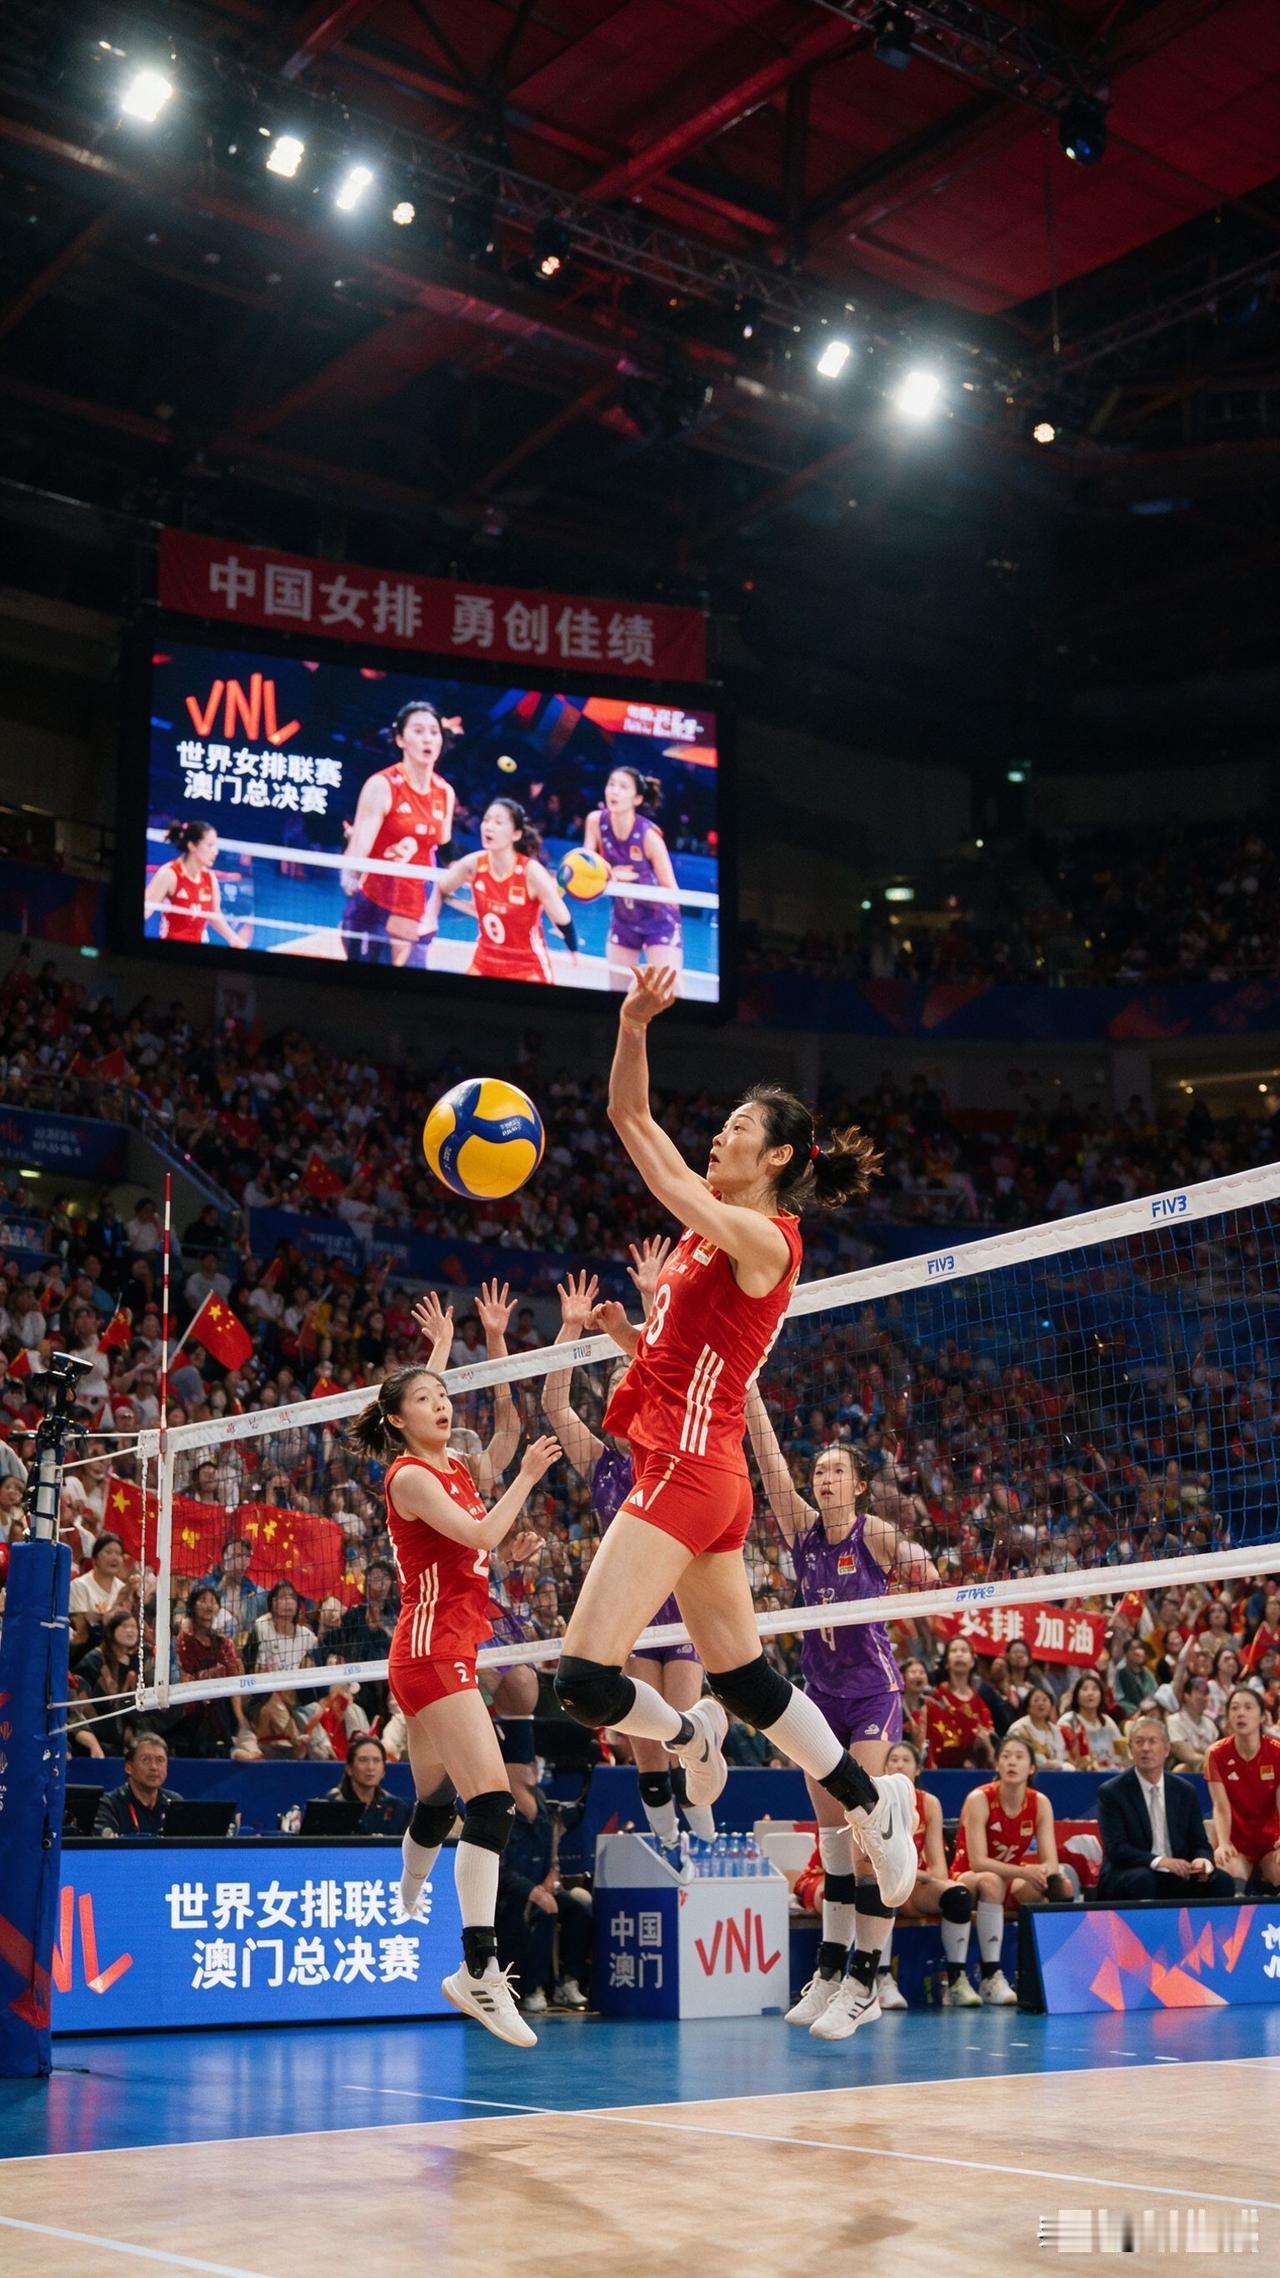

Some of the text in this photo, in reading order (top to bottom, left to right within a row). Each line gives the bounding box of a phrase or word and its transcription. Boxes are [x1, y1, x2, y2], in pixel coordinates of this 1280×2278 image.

[208, 554, 656, 667] 中国女排 勇创佳绩
[185, 672, 301, 746] VNL
[176, 740, 343, 788] 世界女排联赛
[184, 770, 328, 815] 澳门总决赛
[1033, 1610, 1095, 1656] 加油
[165, 1879, 433, 1930] 世界女排联赛
[610, 1911, 662, 1948] 中国
[694, 1907, 781, 1976] VNL
[190, 1934, 420, 1990] 澳门总决赛
[609, 1951, 663, 1989] 澳门
